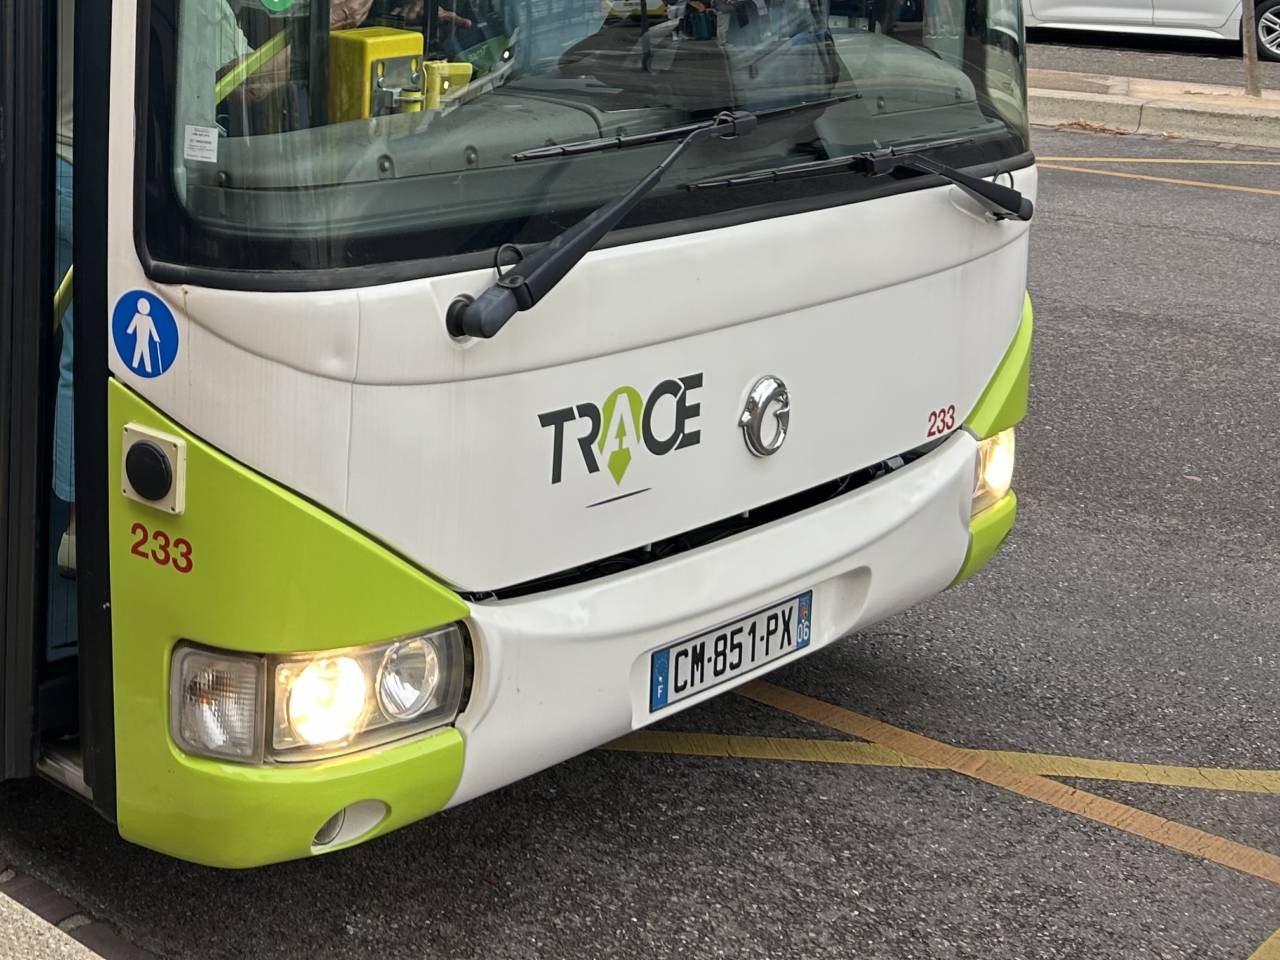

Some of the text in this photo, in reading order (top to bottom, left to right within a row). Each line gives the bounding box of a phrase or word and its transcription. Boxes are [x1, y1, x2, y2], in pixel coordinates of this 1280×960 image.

[537, 372, 704, 487] TRACE
[927, 404, 956, 438] 233
[130, 522, 193, 574] 233
[657, 606, 810, 699] F CM-851-PX 06
